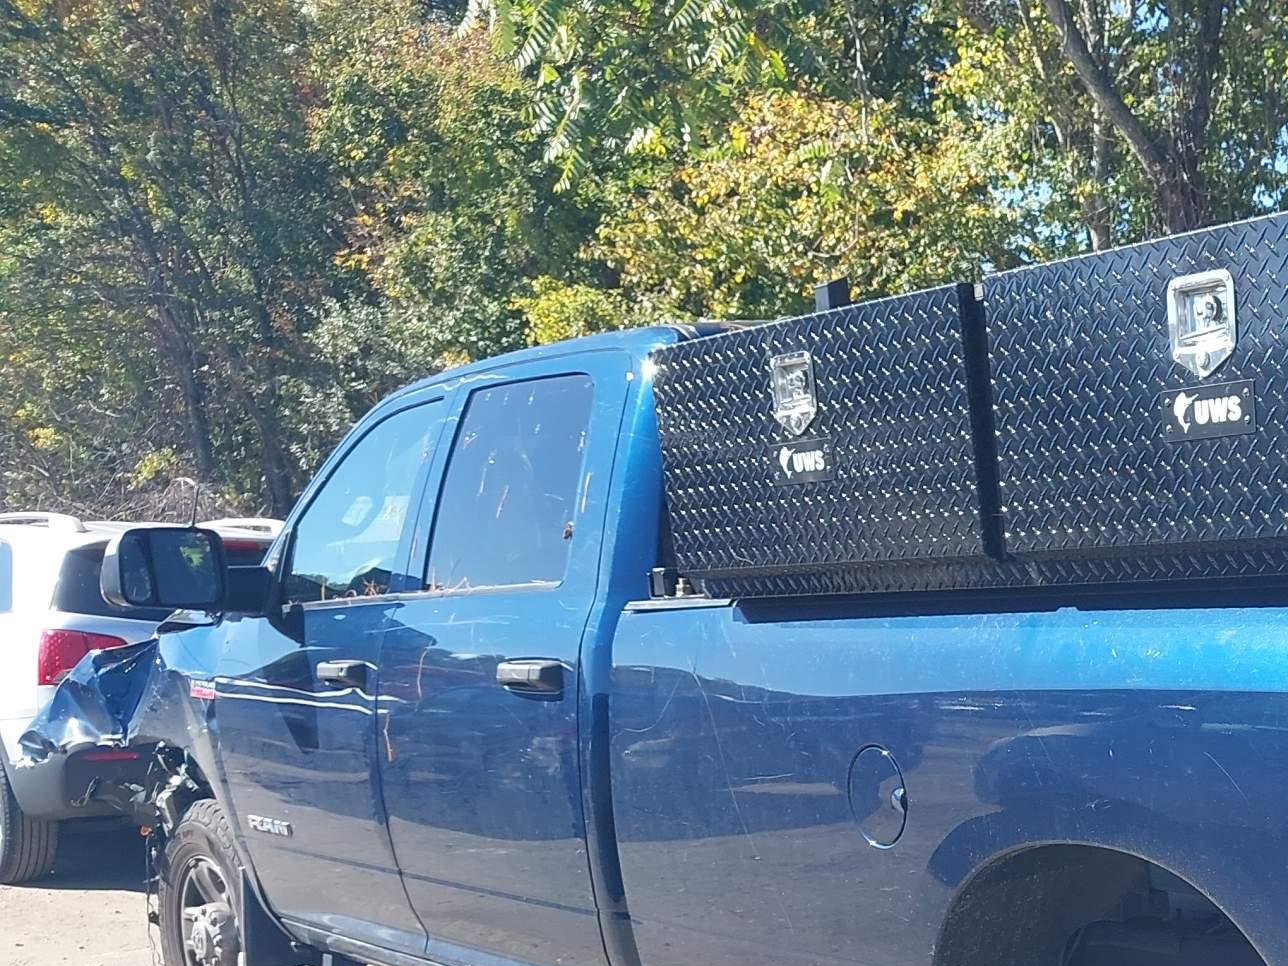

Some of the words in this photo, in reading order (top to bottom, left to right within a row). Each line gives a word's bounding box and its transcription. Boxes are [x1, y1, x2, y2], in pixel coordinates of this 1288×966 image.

[1194, 395, 1242, 425] UWS
[792, 449, 825, 472] UWS
[247, 814, 291, 836] RAM
